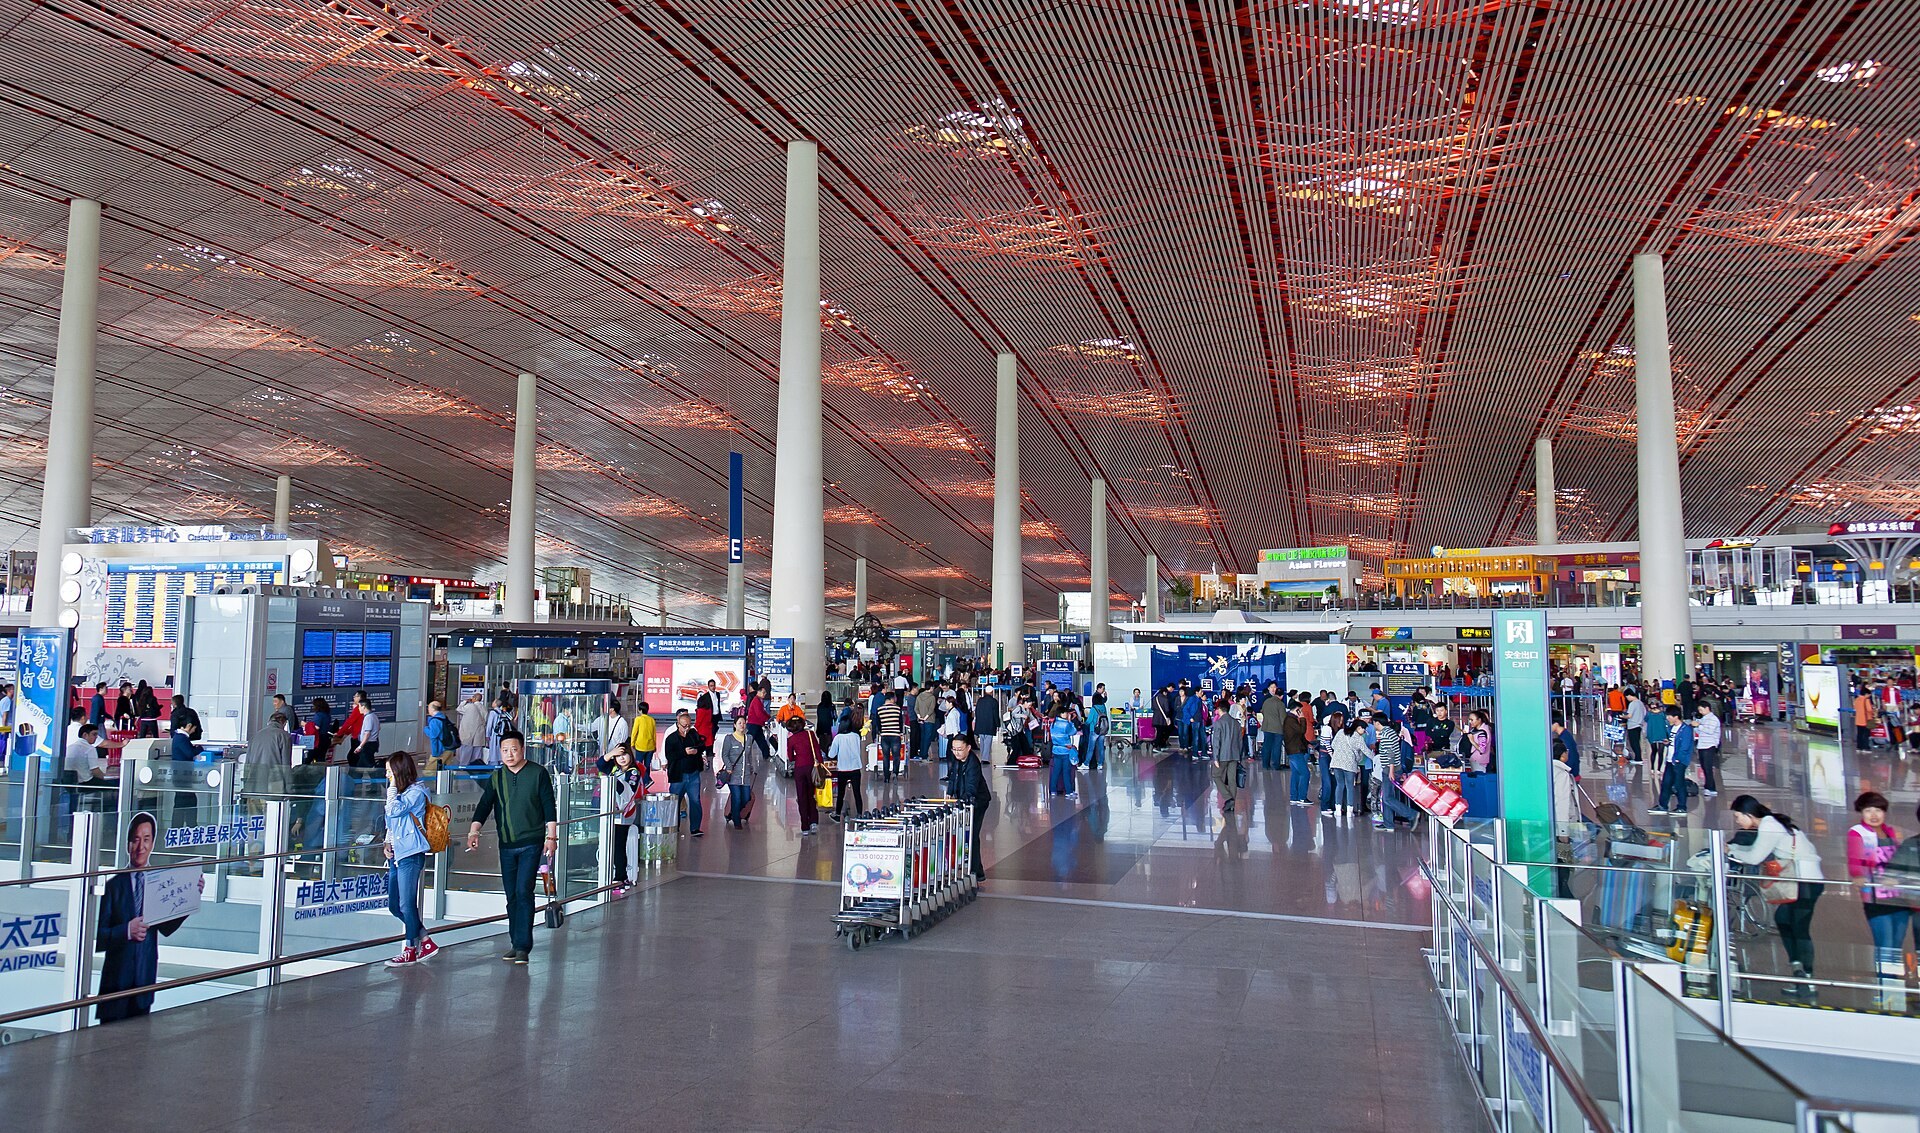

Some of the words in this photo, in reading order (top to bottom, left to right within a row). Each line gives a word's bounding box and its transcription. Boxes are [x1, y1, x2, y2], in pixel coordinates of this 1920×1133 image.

[91, 527, 181, 544] 旅客服务中心
[732, 539, 740, 559] E
[1289, 561, 1311, 569] Asian
[1314, 560, 1346, 568] Flavors
[458, 637, 464, 647] E
[711, 641, 729, 652] H-L
[20, 641, 49, 668] 行李
[1504, 651, 1538, 659] 安全出口
[22, 667, 55, 689] 打包
[165, 815, 265, 846] 保险就是保太平
[295, 910, 317, 920] CHINA
[318, 904, 344, 916] TAIPING
[346, 899, 383, 912] INSURANCE
[0, 912, 61, 949] 太平
[0, 951, 57, 973] AIPING
